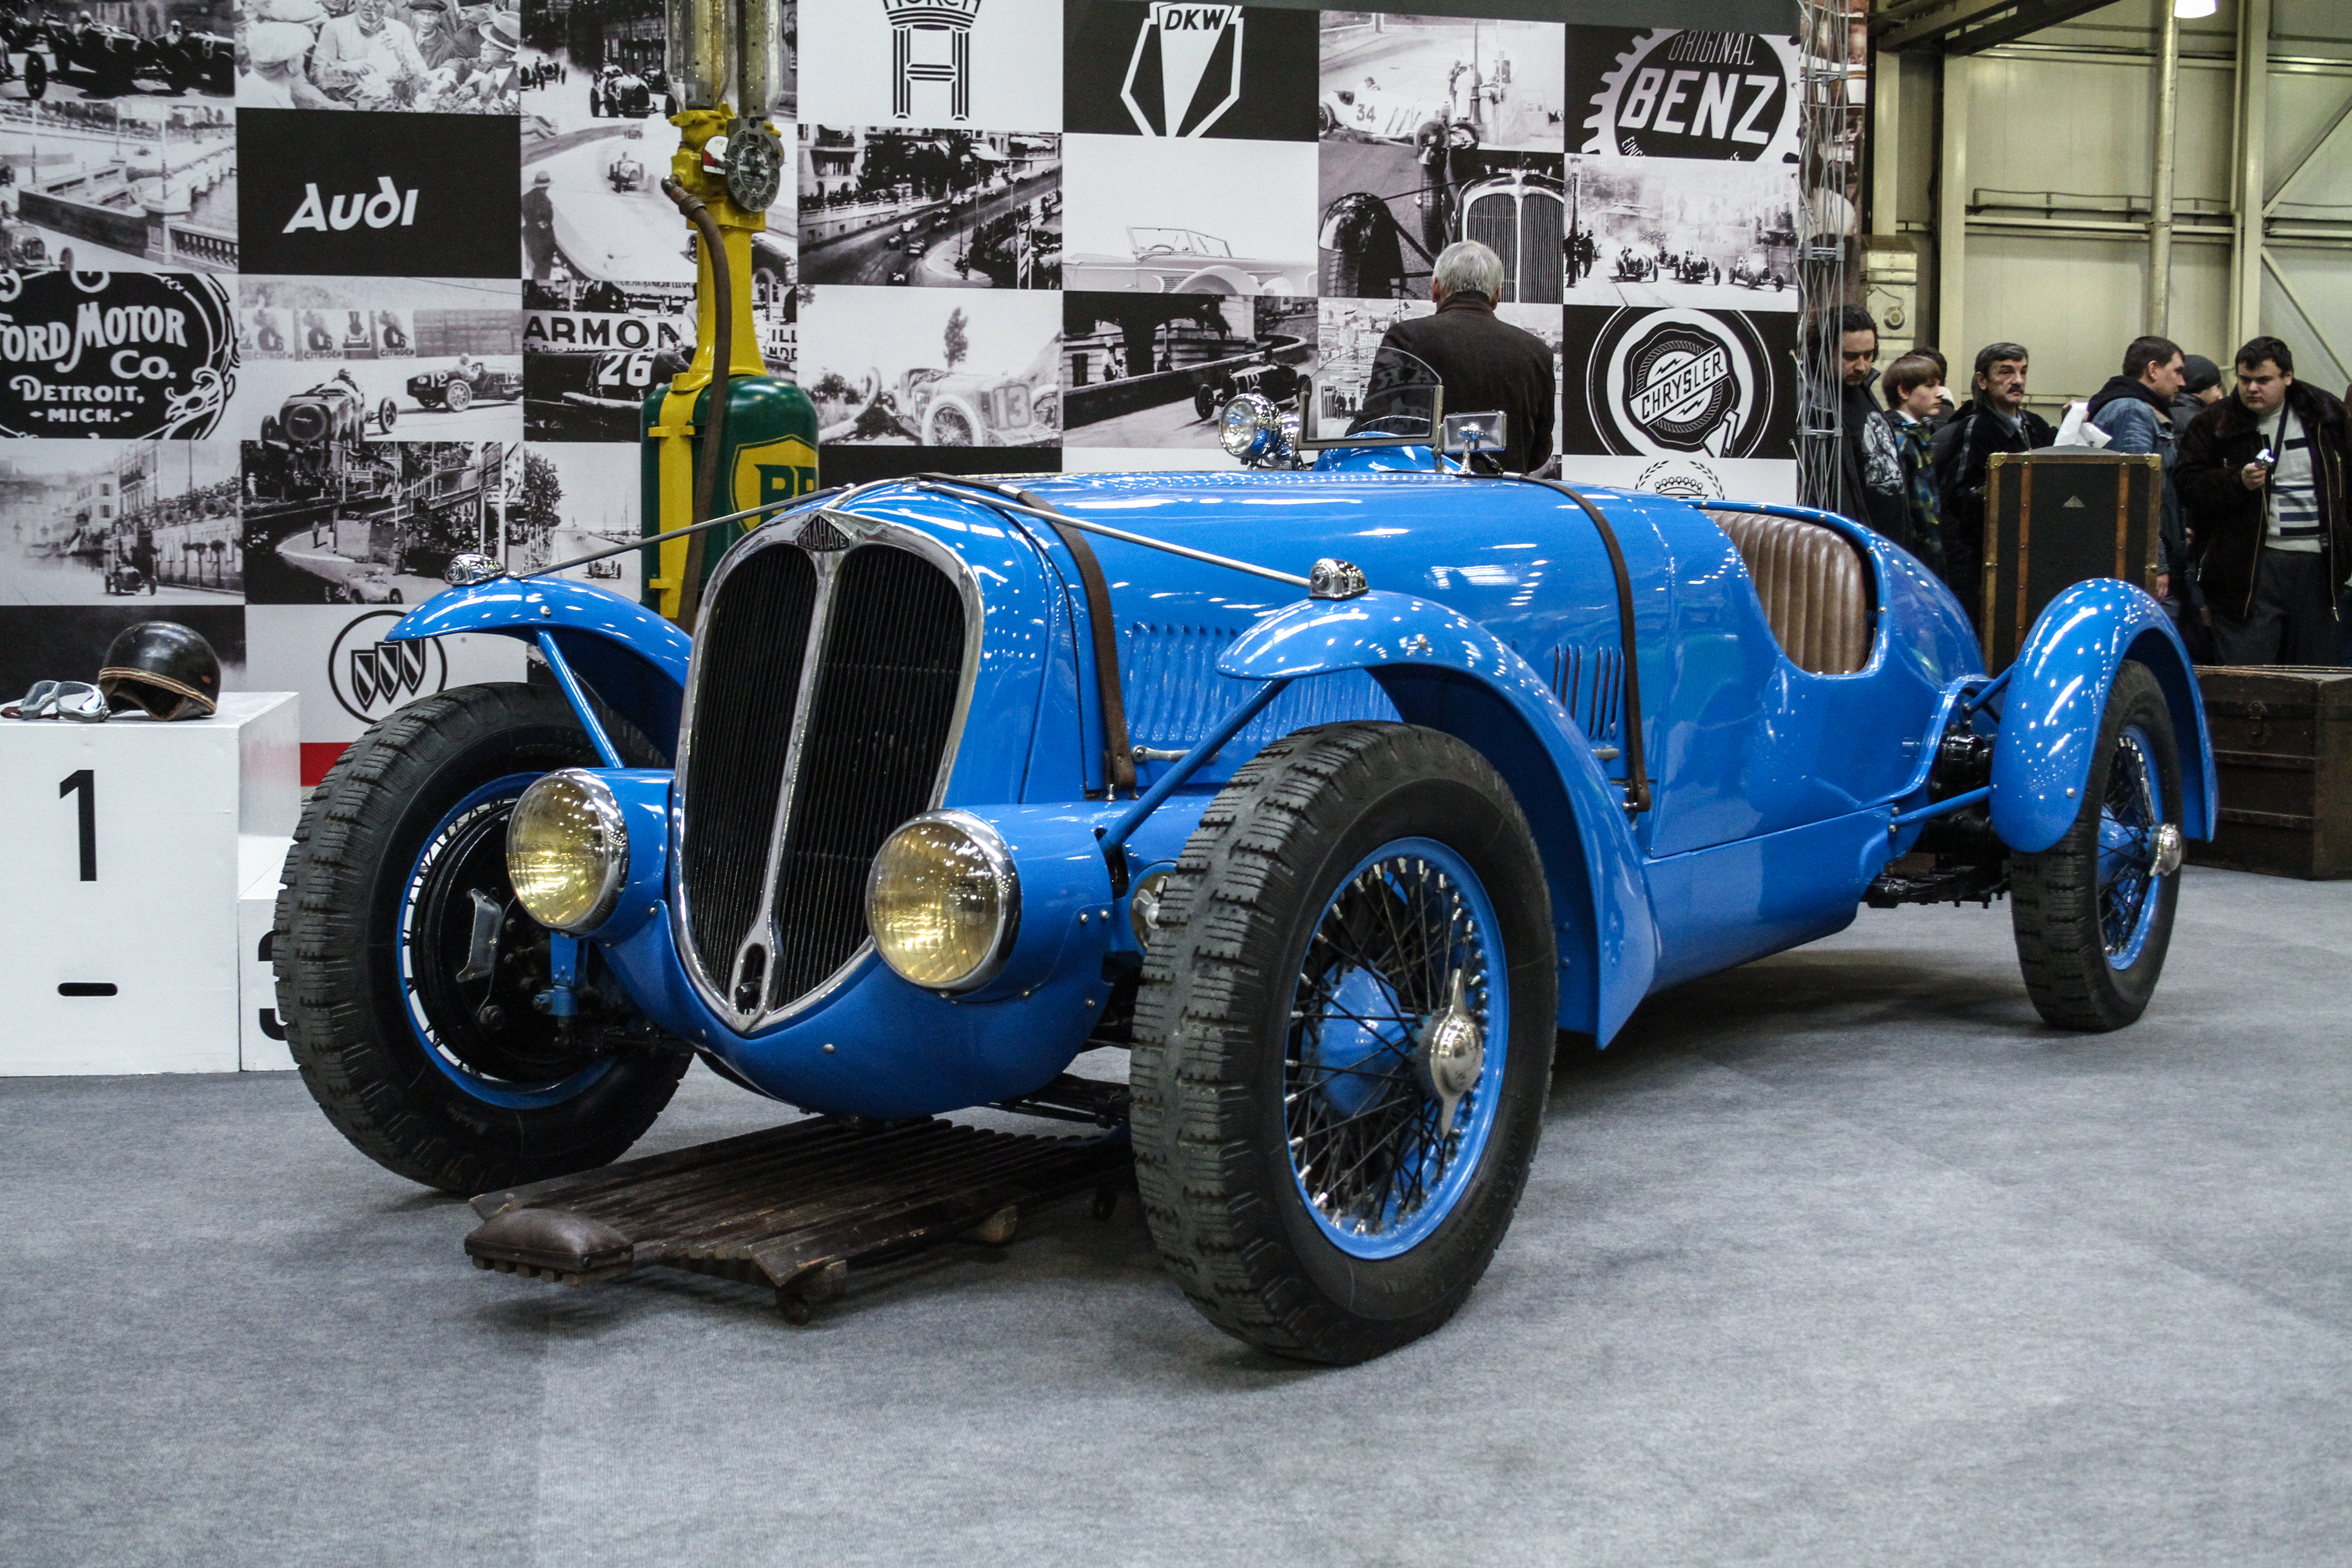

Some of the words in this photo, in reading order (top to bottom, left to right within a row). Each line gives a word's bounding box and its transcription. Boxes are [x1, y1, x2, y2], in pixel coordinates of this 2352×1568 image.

[1165, 9, 1225, 30] DKW
[1668, 30, 1754, 66] ORIGINAL
[1357, 103, 1376, 123] 34
[1617, 68, 1779, 144] BENZ
[54, 301, 187, 373] MOTOR
[431, 372, 449, 387] 12
[598, 351, 658, 387] 26
[1642, 351, 1723, 420] CHRYSLER
[10, 375, 144, 403] DETROIT.
[997, 386, 1029, 428] 13
[48, 408, 120, 422] MICH.
[799, 517, 847, 549] DELAHAYE
[59, 769, 97, 882] 1
